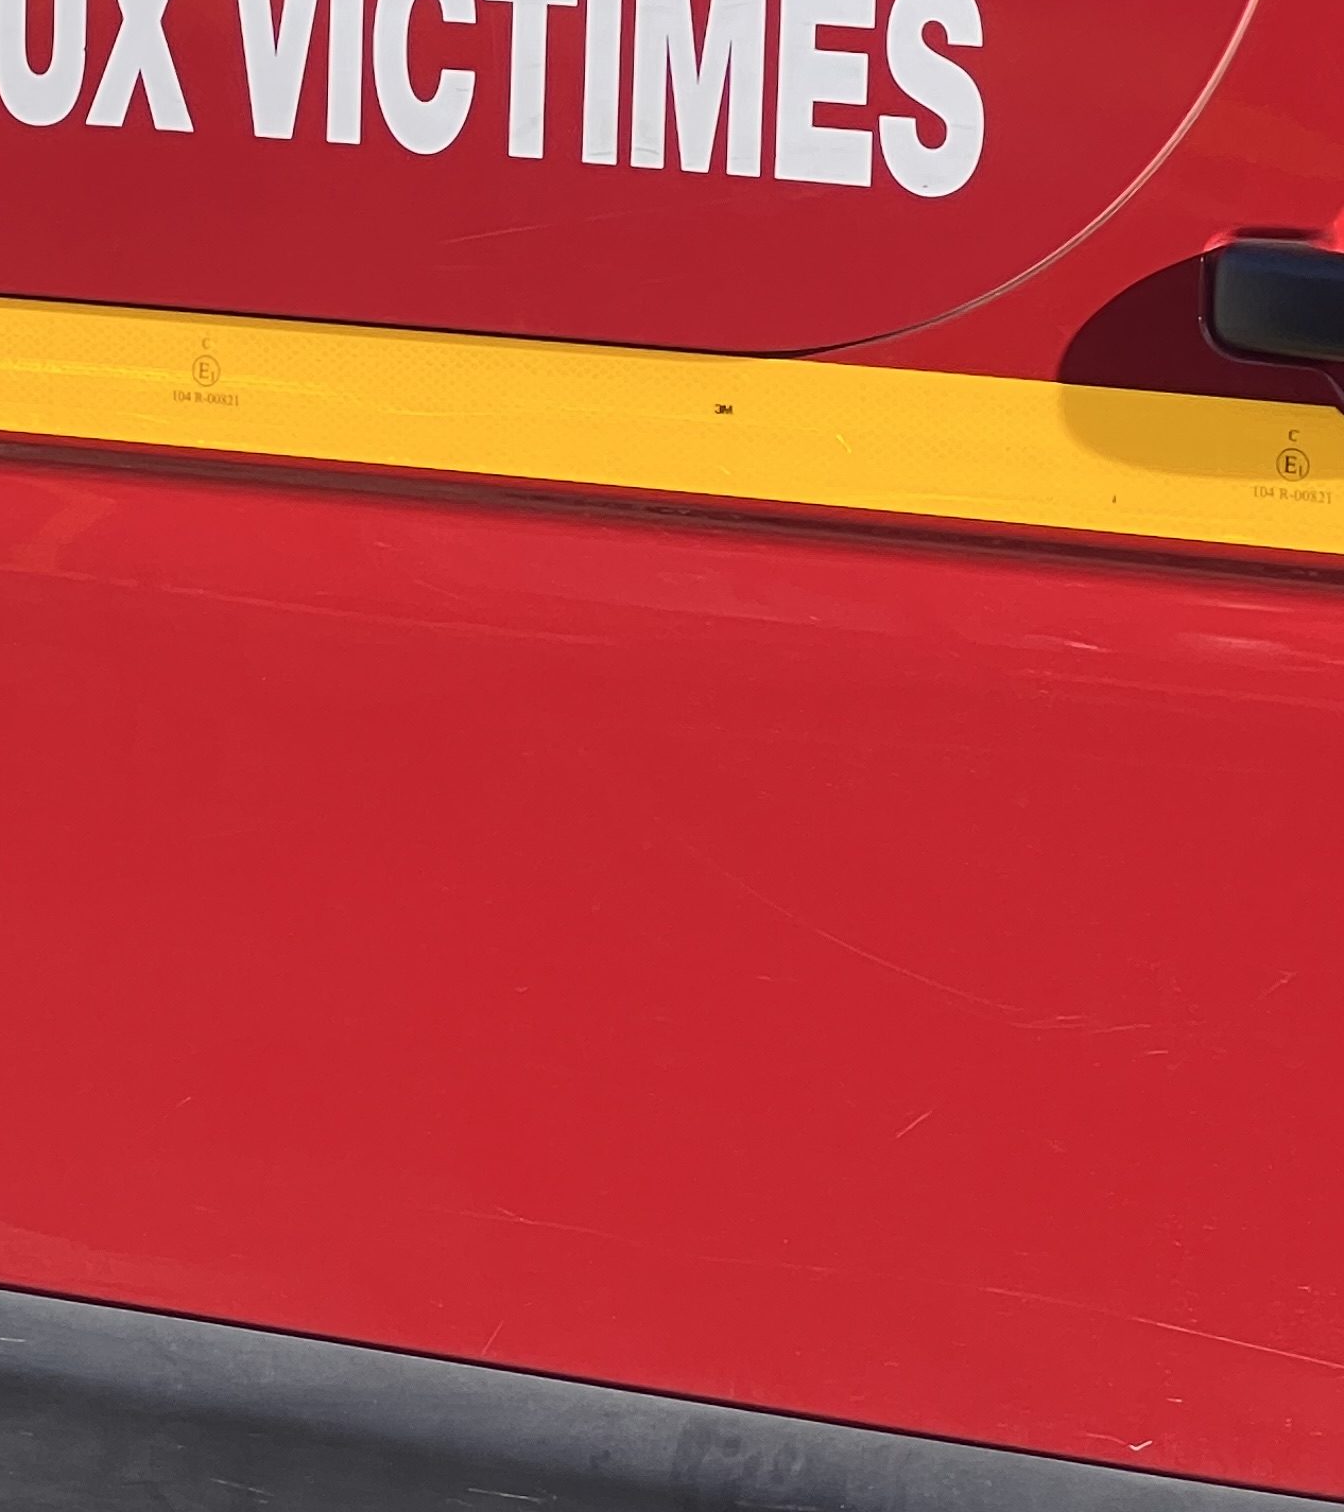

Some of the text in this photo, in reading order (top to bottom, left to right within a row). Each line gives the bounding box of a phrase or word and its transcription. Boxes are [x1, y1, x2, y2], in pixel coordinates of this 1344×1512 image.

[714, 403, 733, 415] 3M
[1288, 429, 1300, 442] C
[1253, 485, 1275, 498] 104
